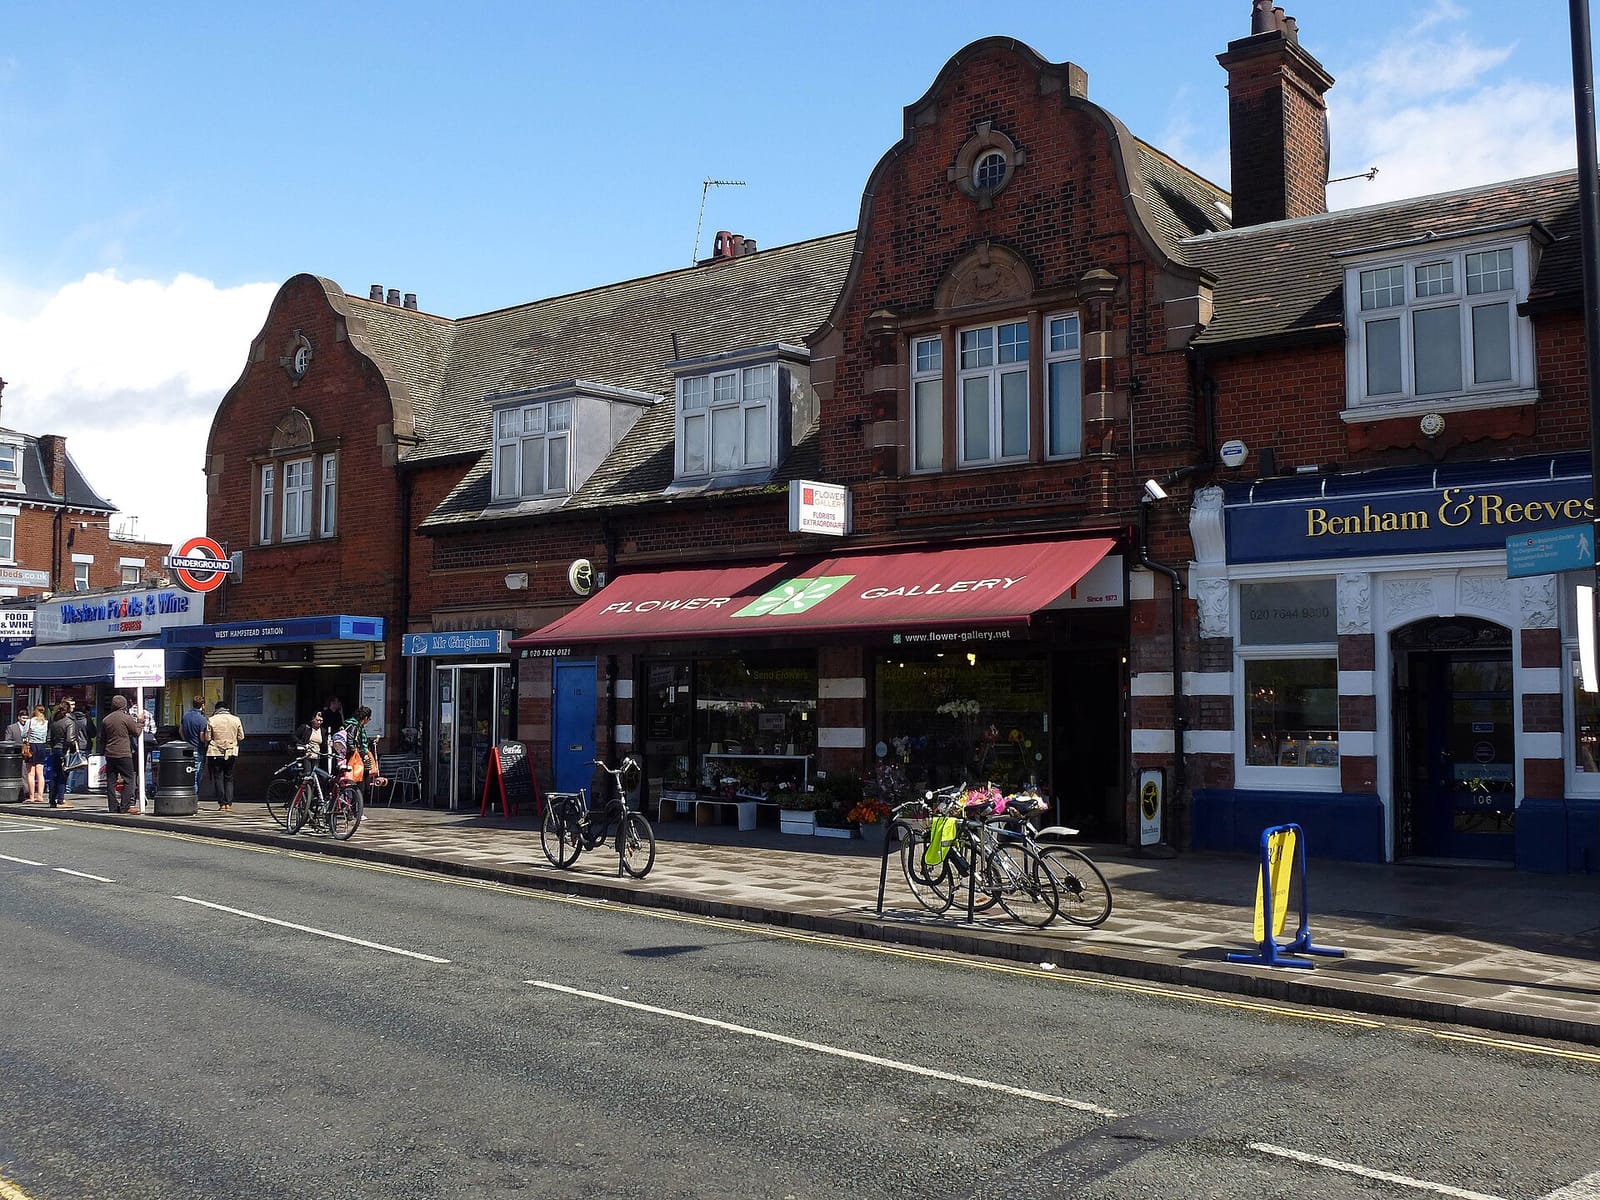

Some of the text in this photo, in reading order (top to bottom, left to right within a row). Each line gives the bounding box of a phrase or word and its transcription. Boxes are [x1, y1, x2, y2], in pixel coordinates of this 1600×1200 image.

[814, 490, 846, 501] FLOWER
[812, 511, 836, 520] FLORISTS
[1305, 488, 1594, 537] Benham & Reeves
[172, 558, 230, 570] UNDERGROUND
[860, 575, 1027, 600] GALLERY
[60, 603, 106, 625] Western
[145, 594, 156, 616] &
[158, 591, 190, 614] Wine
[599, 597, 731, 616] FLOWER
[5, 613, 29, 621] FOOD
[1250, 608, 1270, 621] 020
[1272, 607, 1298, 620] 7644
[9, 621, 34, 629] WINE
[214, 626, 284, 639] WEST HAMPSTEAD STATION
[905, 630, 1011, 642] www.flower-gallery.net
[432, 635, 491, 652] Mr Gingham
[529, 648, 571, 657] 020 7624 0121
[1472, 794, 1493, 805] 106
